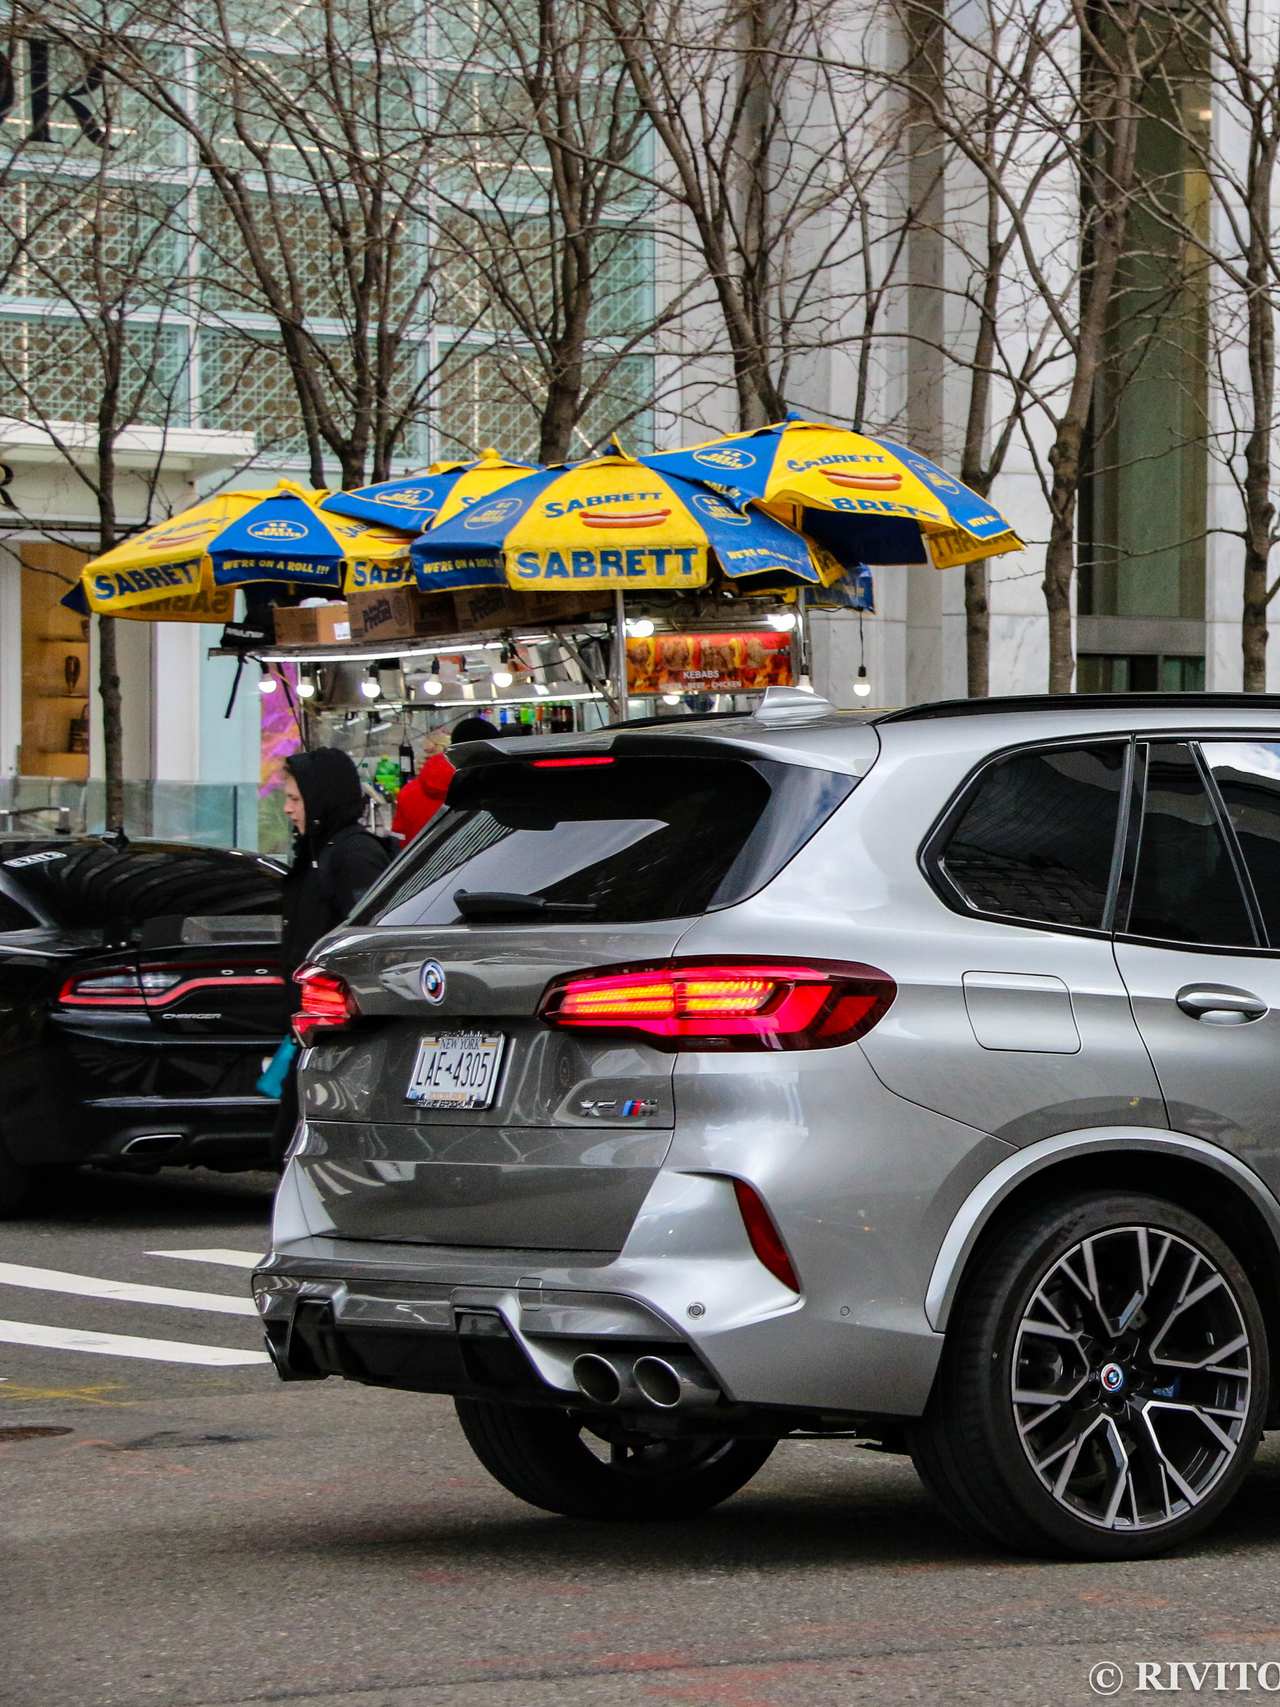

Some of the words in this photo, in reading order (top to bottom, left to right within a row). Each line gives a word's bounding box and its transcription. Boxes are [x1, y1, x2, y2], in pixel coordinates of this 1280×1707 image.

[544, 492, 663, 518] SABRETT
[222, 559, 256, 571] WE'RE
[258, 559, 274, 568] ON
[276, 560, 284, 570] A
[287, 561, 314, 573] ROLL
[514, 547, 699, 579] SABRETT
[683, 669, 720, 679] KEBABS
[711, 680, 742, 688] CHICKEN
[440, 1038, 458, 1050] NEW
[460, 1039, 480, 1050] YORK
